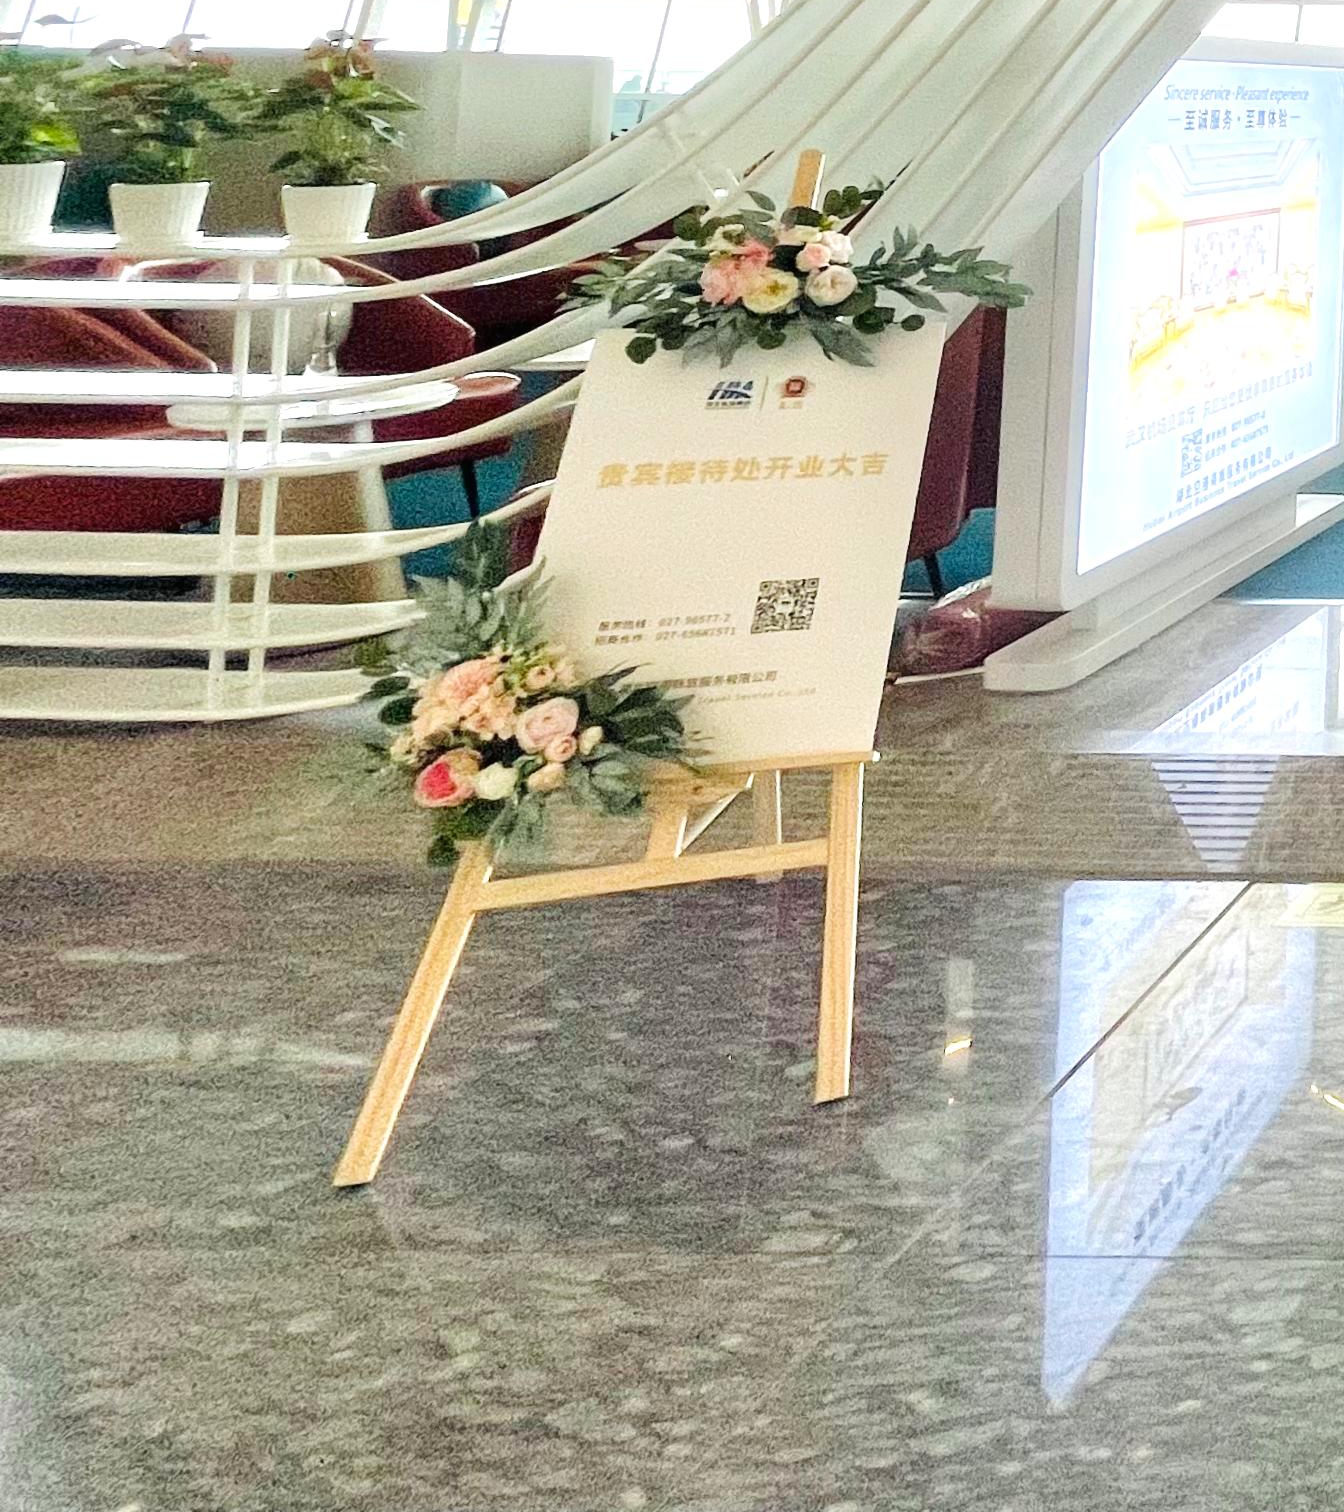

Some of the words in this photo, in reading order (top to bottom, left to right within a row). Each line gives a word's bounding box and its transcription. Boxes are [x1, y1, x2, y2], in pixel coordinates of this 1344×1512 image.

[597, 452, 889, 488] 贵宾接待处开业大吉
